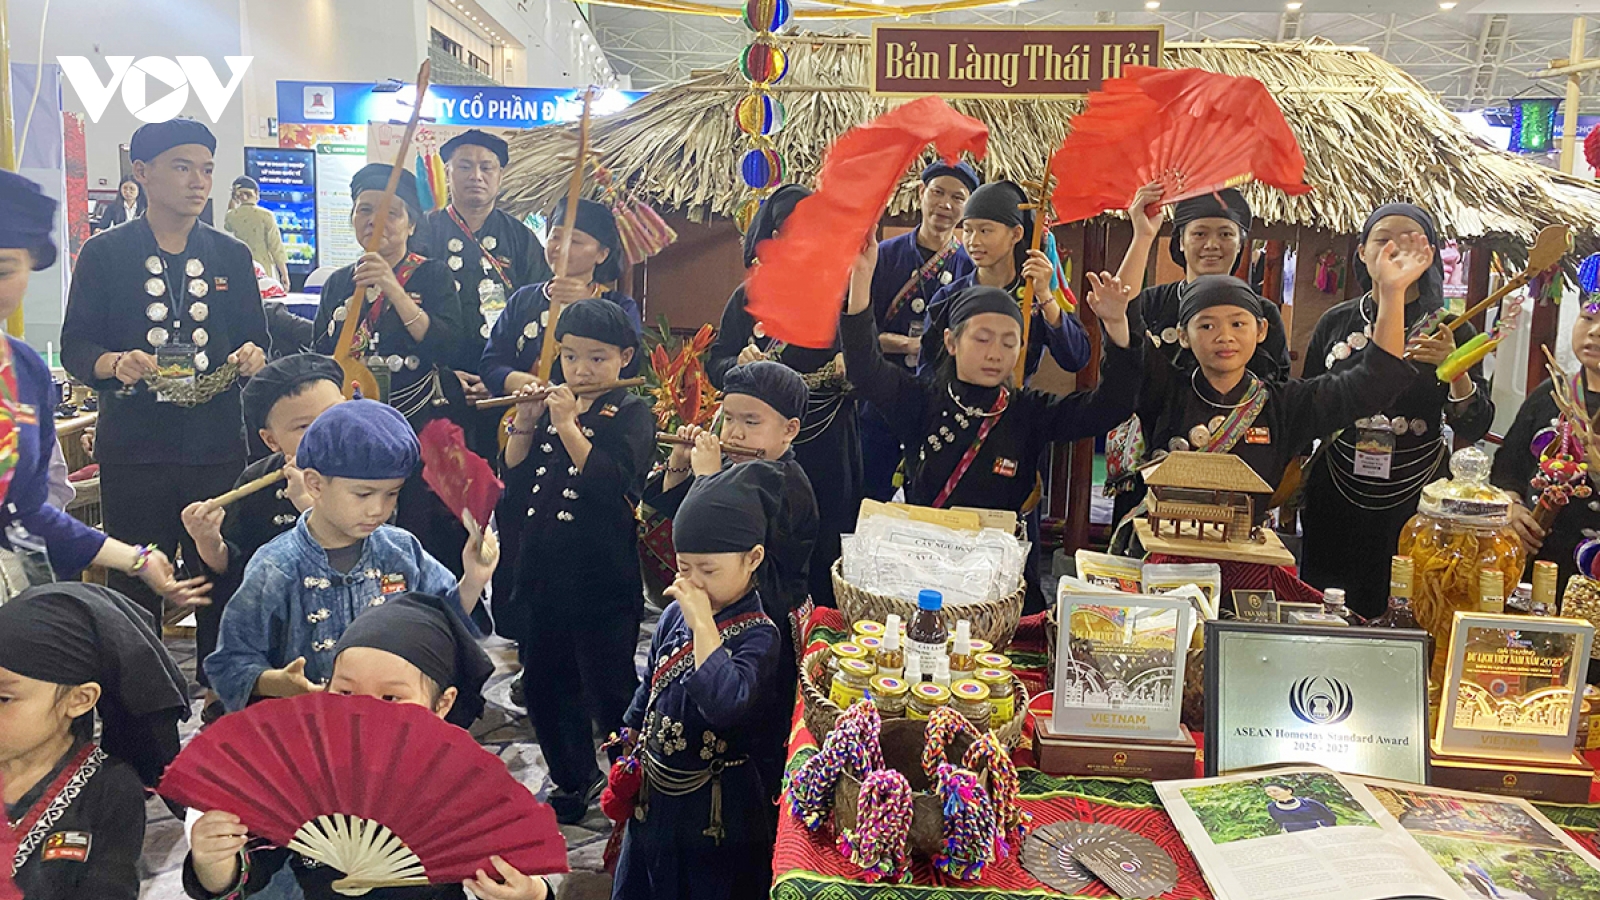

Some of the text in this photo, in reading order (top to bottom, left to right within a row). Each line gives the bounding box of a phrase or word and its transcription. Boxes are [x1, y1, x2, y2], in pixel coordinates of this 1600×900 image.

[885, 41, 940, 80] Bản
[948, 43, 1020, 88] Làng
[1023, 43, 1090, 81] Thái
[459, 92, 483, 119] CỔ
[488, 95, 537, 121] PHẦN
[1091, 713, 1147, 724] VIETNAM
[1233, 727, 1272, 737] ASEAN
[1376, 735, 1409, 746] Award
[1481, 734, 1539, 746] VIETNAM
[1294, 741, 1317, 751] 2025
